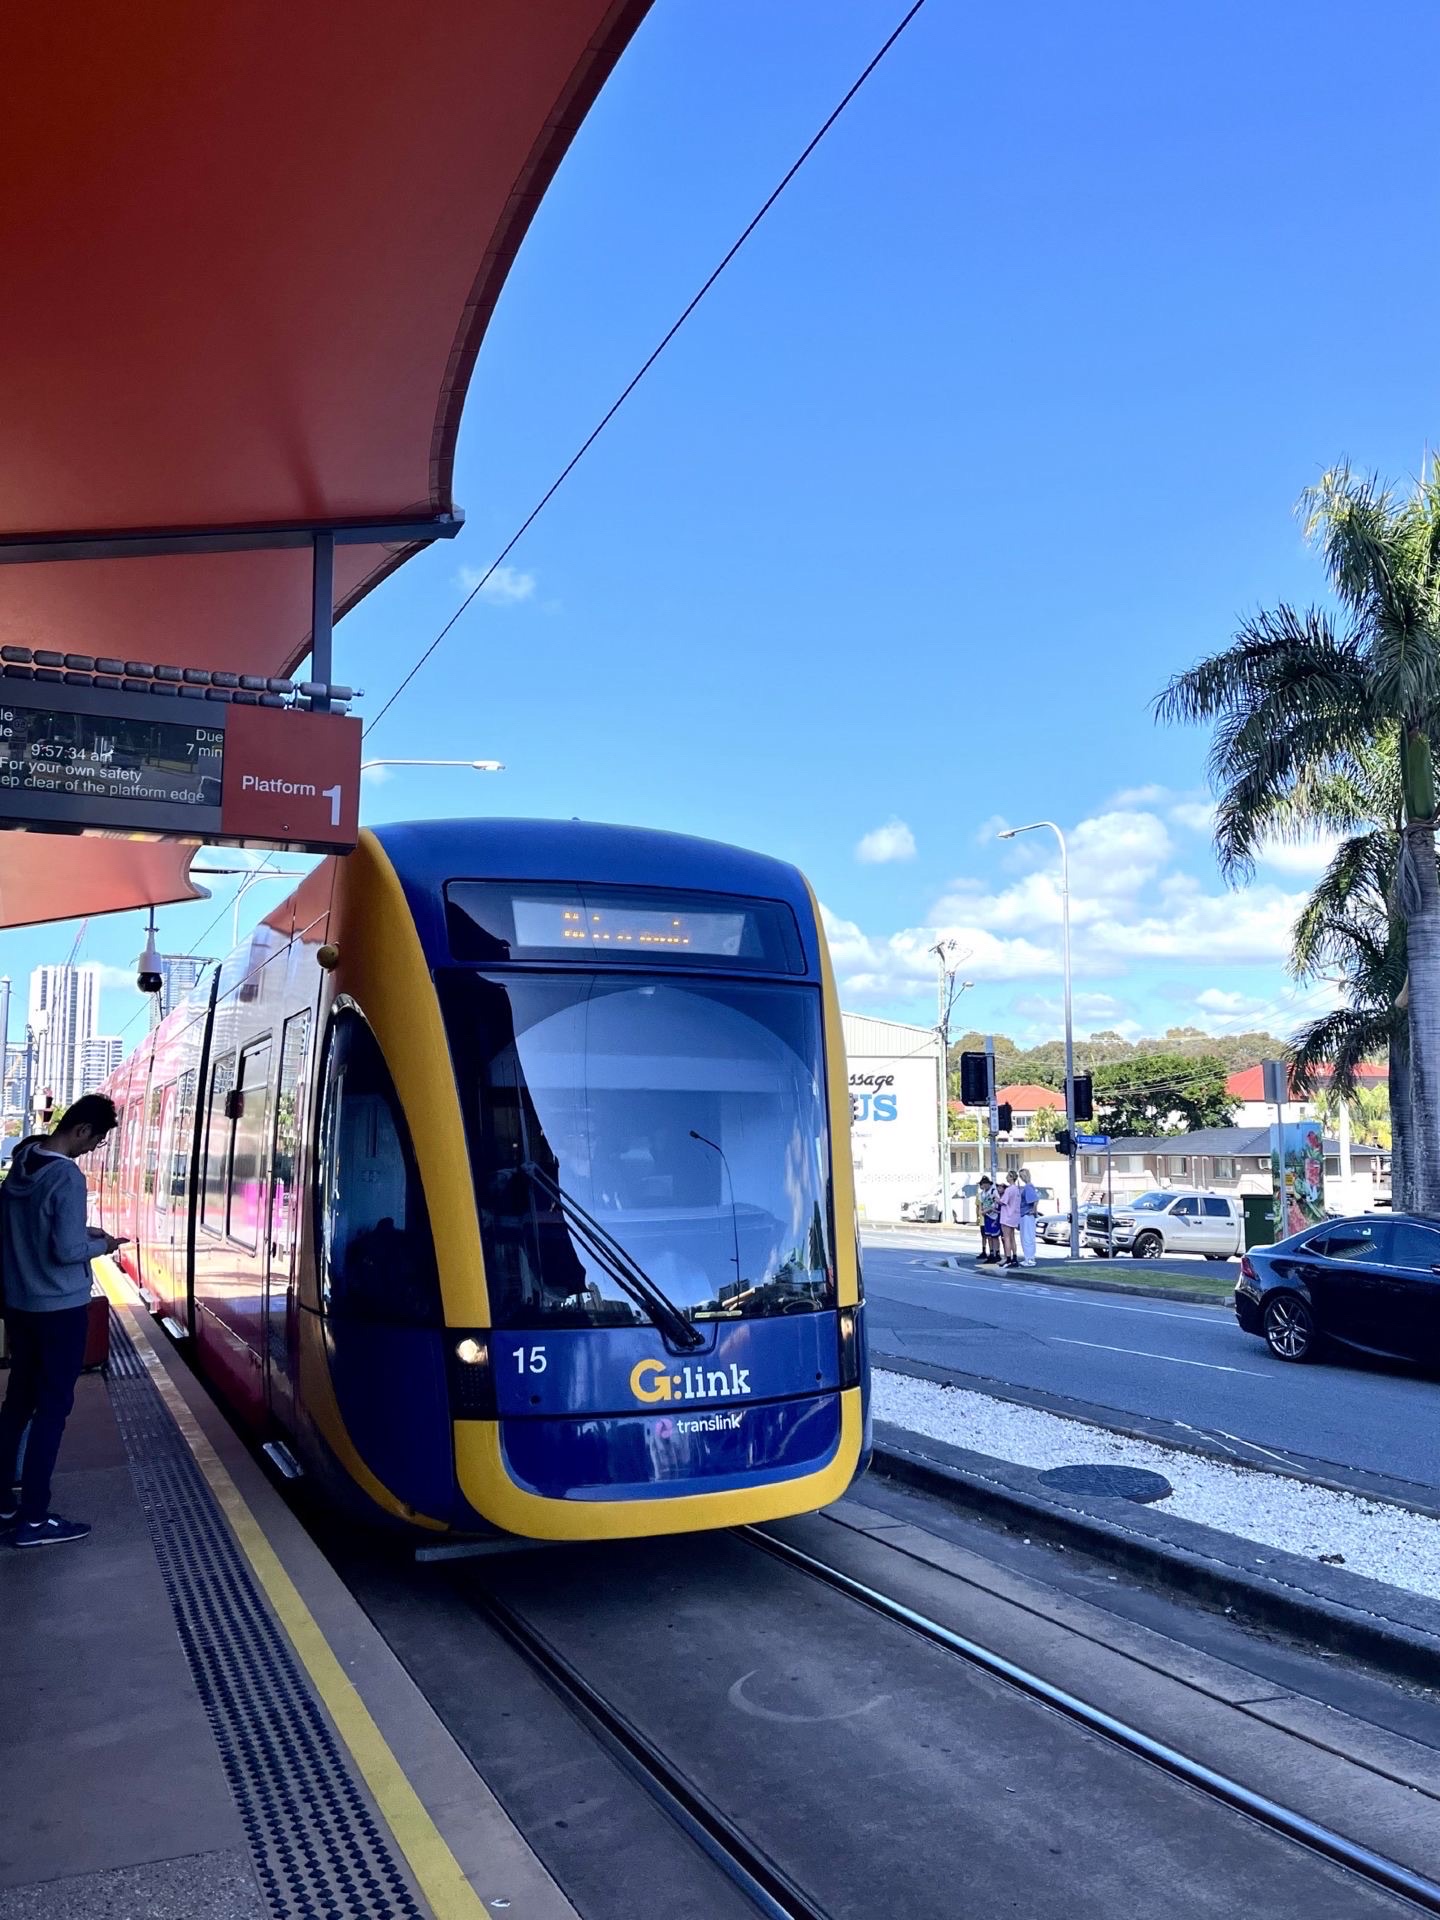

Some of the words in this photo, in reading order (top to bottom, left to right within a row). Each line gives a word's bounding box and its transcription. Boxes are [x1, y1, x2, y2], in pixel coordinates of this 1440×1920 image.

[196, 729, 223, 742] Due
[31, 743, 86, 760] 9:57:34
[91, 752, 113, 763] am
[186, 743, 195, 755] 7
[198, 745, 223, 758] min
[0, 756, 25, 770] For
[29, 761, 62, 775] your
[65, 764, 95, 777] own
[99, 766, 142, 784] safety
[24, 775, 62, 789] clear
[65, 777, 79, 791] of
[83, 780, 105, 793] the
[109, 783, 166, 798] platform
[170, 789, 205, 804] edge
[242, 775, 316, 796] Platform
[322, 784, 342, 826] 1
[512, 1346, 547, 1374] 15
[629, 1358, 751, 1403] G:link
[676, 1413, 742, 1434] translink
